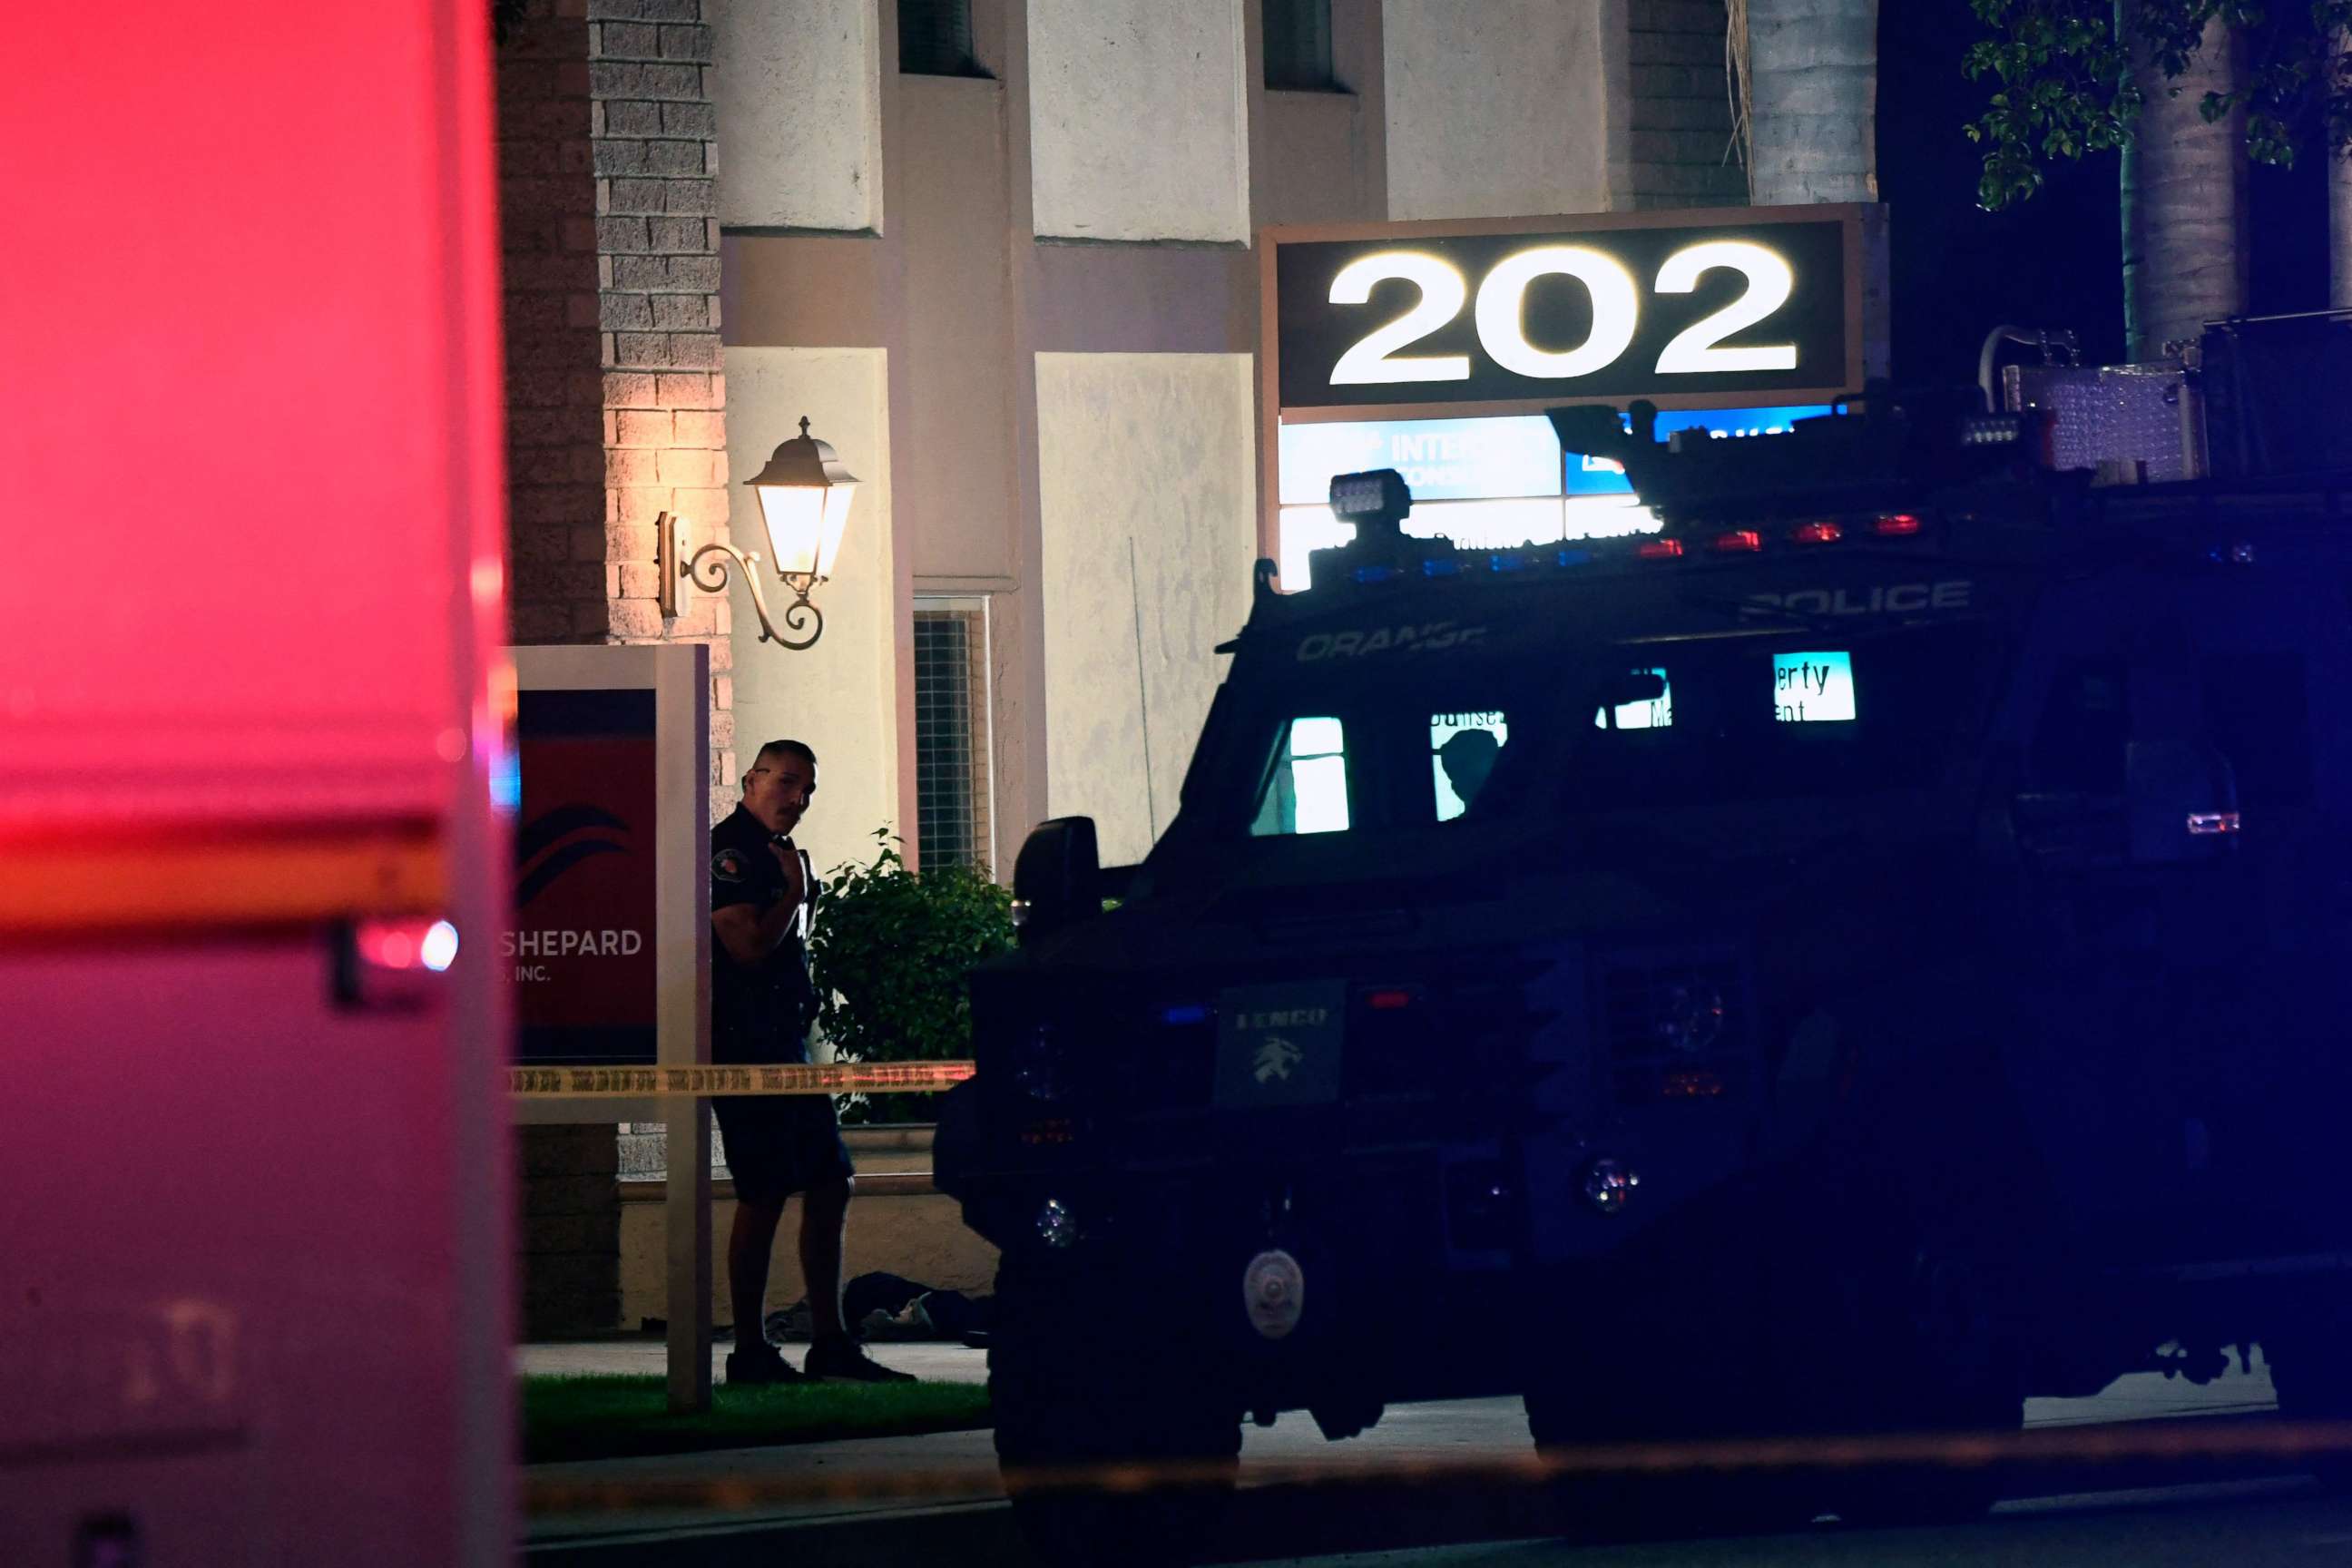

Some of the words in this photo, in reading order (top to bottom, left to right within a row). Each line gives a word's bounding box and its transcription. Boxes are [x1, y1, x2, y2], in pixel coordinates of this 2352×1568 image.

[1328, 240, 1797, 385] 202
[1739, 581, 1972, 621] POLICE
[499, 929, 642, 956] SHEPARD
[515, 965, 551, 982] INC.
